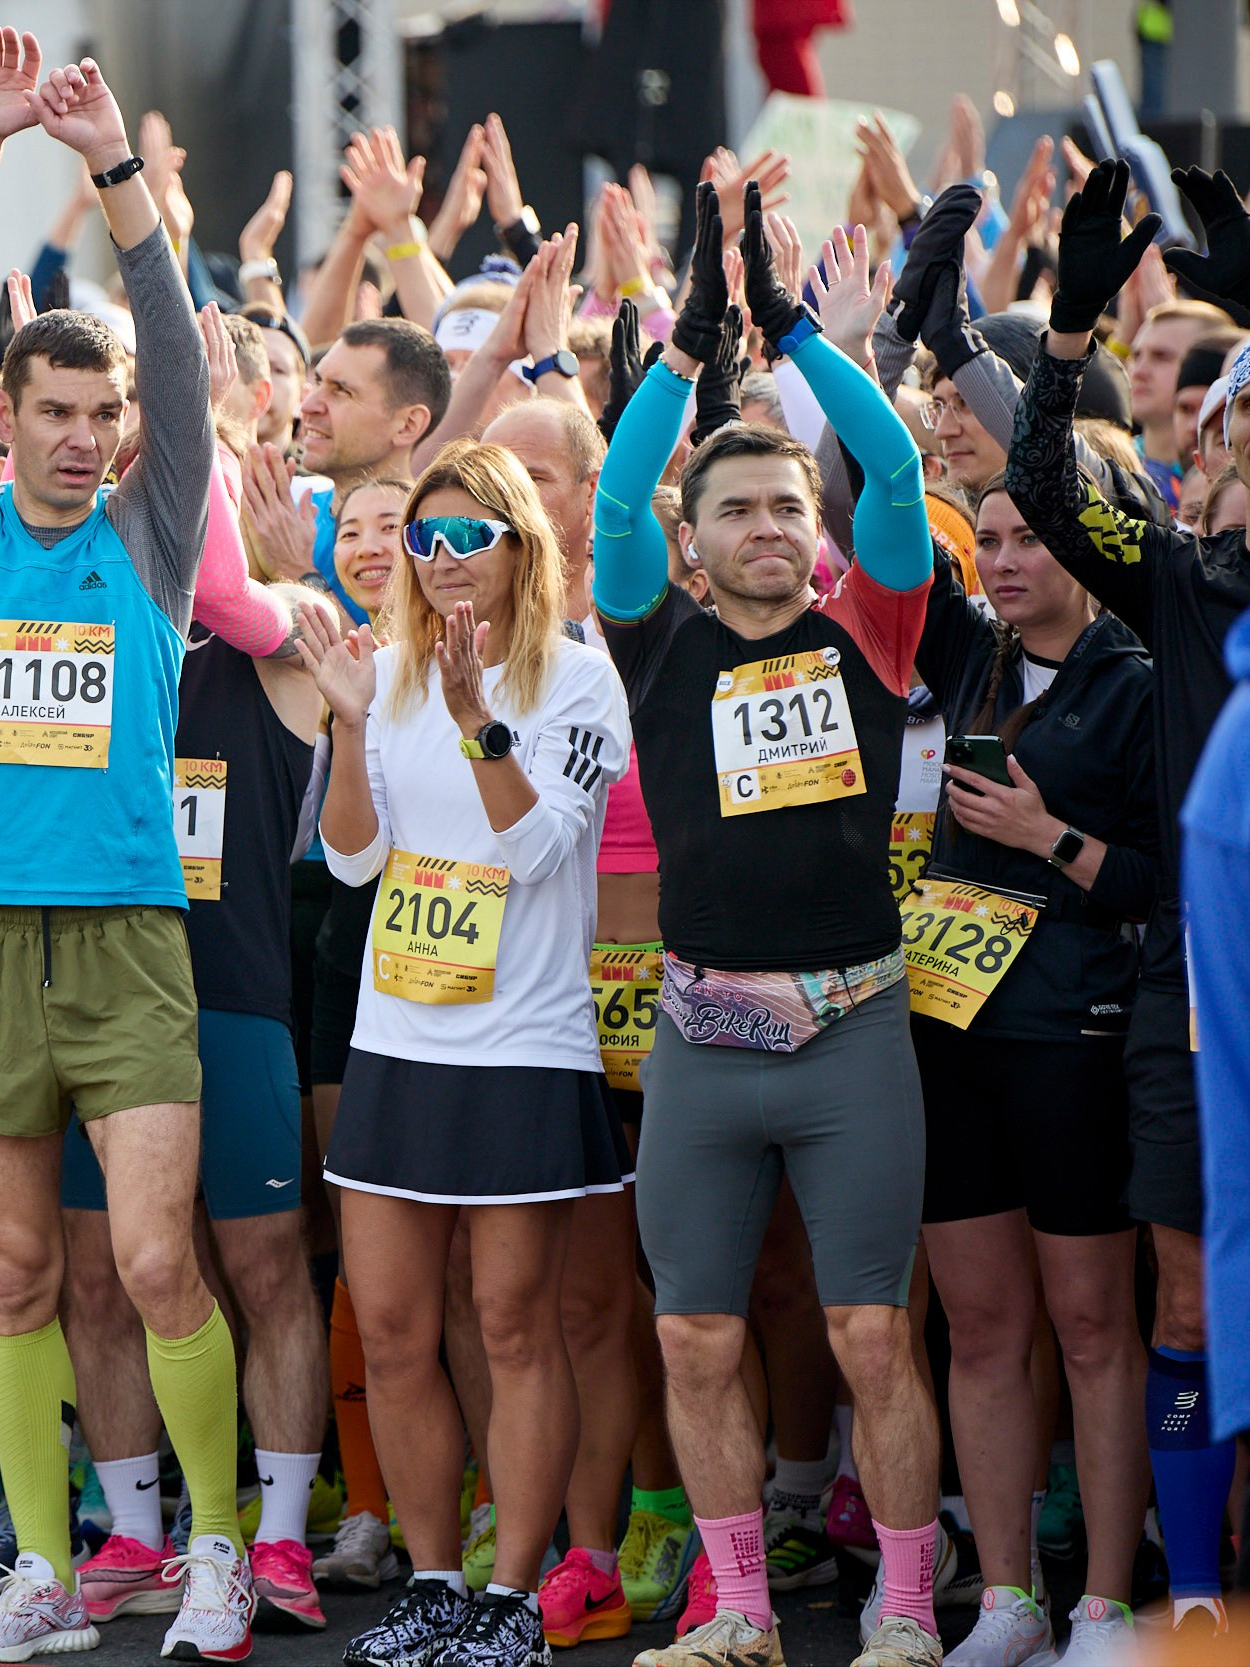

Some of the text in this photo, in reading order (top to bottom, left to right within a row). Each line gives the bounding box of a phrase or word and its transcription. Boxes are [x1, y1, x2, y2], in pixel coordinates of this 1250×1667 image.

[79, 581, 107, 591] adidas
[73, 625, 86, 636] 10
[0, 704, 66, 719] АЛЕКСЕЙ
[734, 688, 839, 746] 1312
[758, 737, 828, 764] ДМИТРИЙ
[183, 760, 197, 771] 10
[180, 796, 197, 836] 1
[466, 864, 480, 876] 10
[385, 888, 480, 945] 2104
[407, 940, 439, 957] АННА
